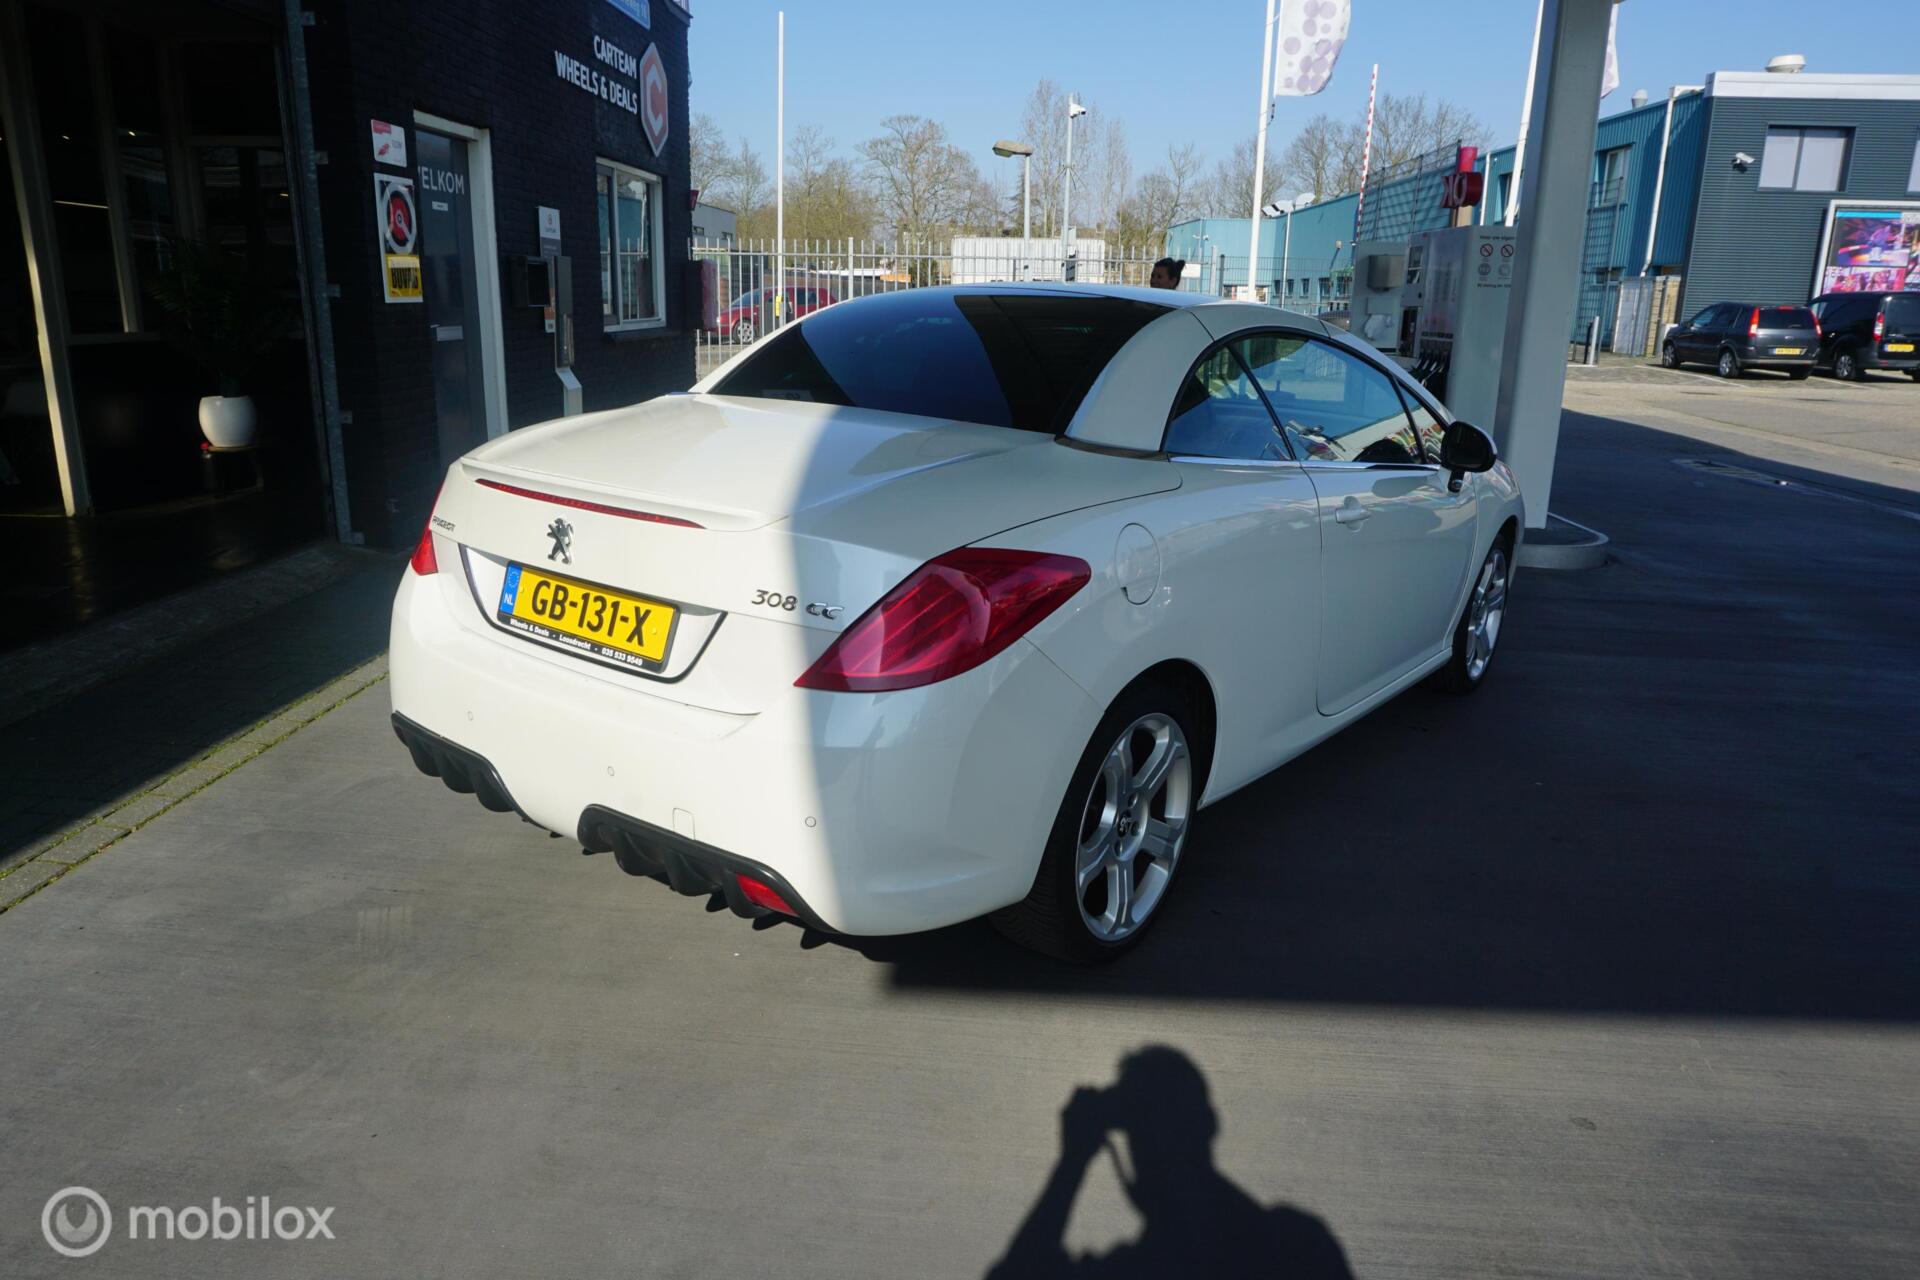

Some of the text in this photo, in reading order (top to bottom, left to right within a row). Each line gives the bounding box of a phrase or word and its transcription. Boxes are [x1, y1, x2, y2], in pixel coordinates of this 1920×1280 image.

[594, 35, 637, 79] CARTEAM
[555, 51, 638, 115] WHEELS & DEALS
[417, 166, 465, 195] ELKOM
[504, 593, 513, 606] NL
[531, 580, 651, 647] GB-131-X
[751, 589, 798, 611] 308
[510, 618, 528, 631] Wheels
[528, 624, 534, 632] &
[534, 626, 550, 637] Deals
[559, 633, 591, 650] Loosdrecht
[601, 647, 613, 657] 035
